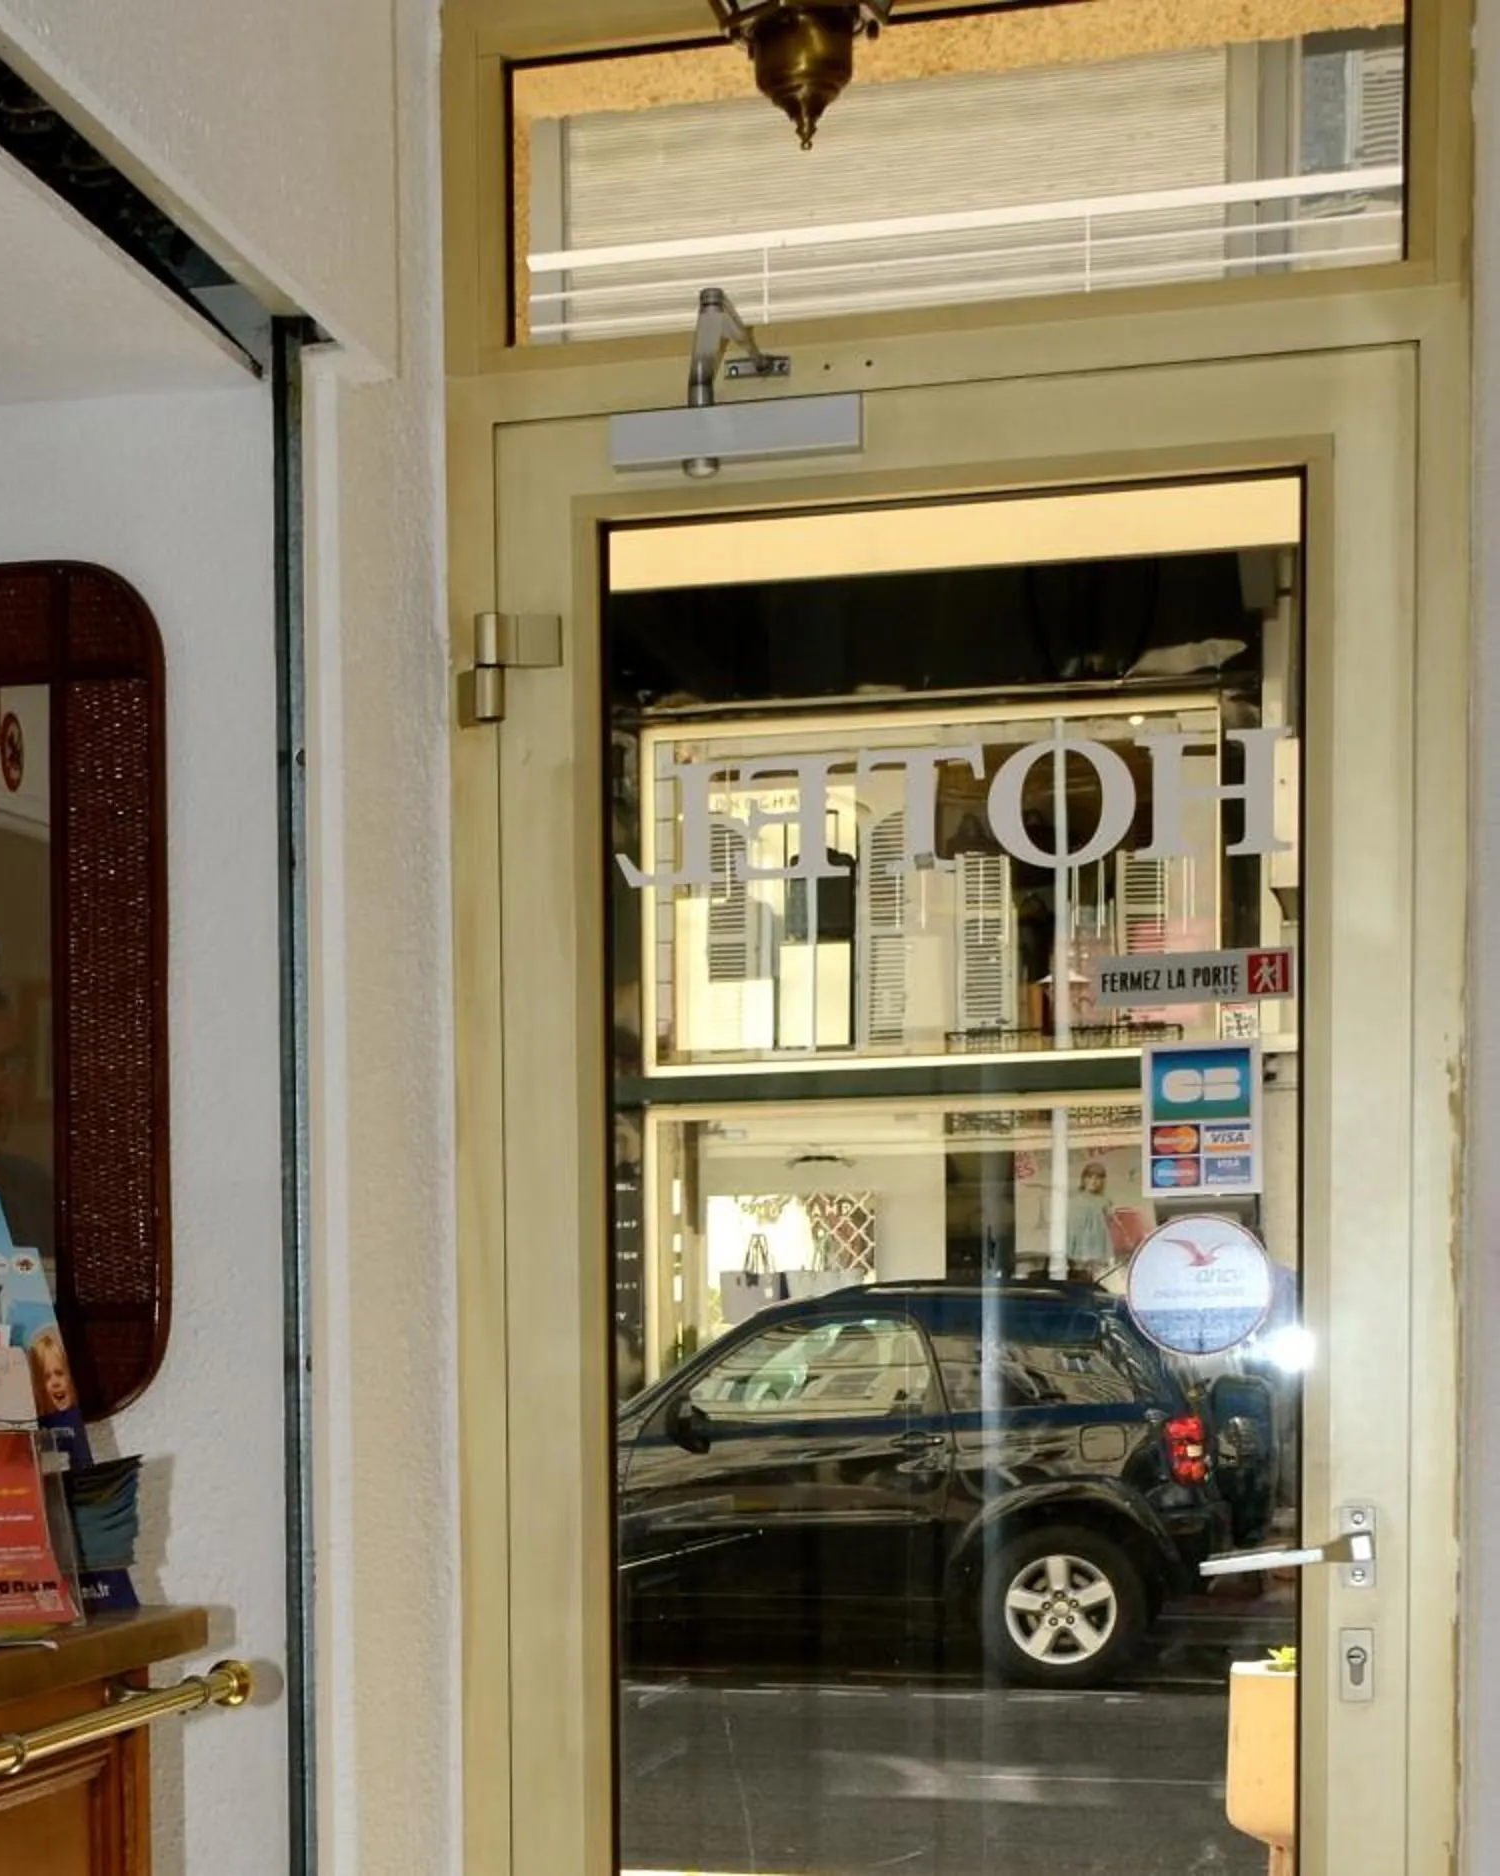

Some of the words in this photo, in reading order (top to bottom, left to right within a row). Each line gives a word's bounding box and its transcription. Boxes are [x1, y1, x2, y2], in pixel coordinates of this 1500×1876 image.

[1100, 970, 1161, 993] FERMEZ
[1167, 967, 1186, 990] LA
[1192, 964, 1240, 987] PORTE
[1160, 1066, 1241, 1103] CB
[1209, 1131, 1245, 1144] VISA
